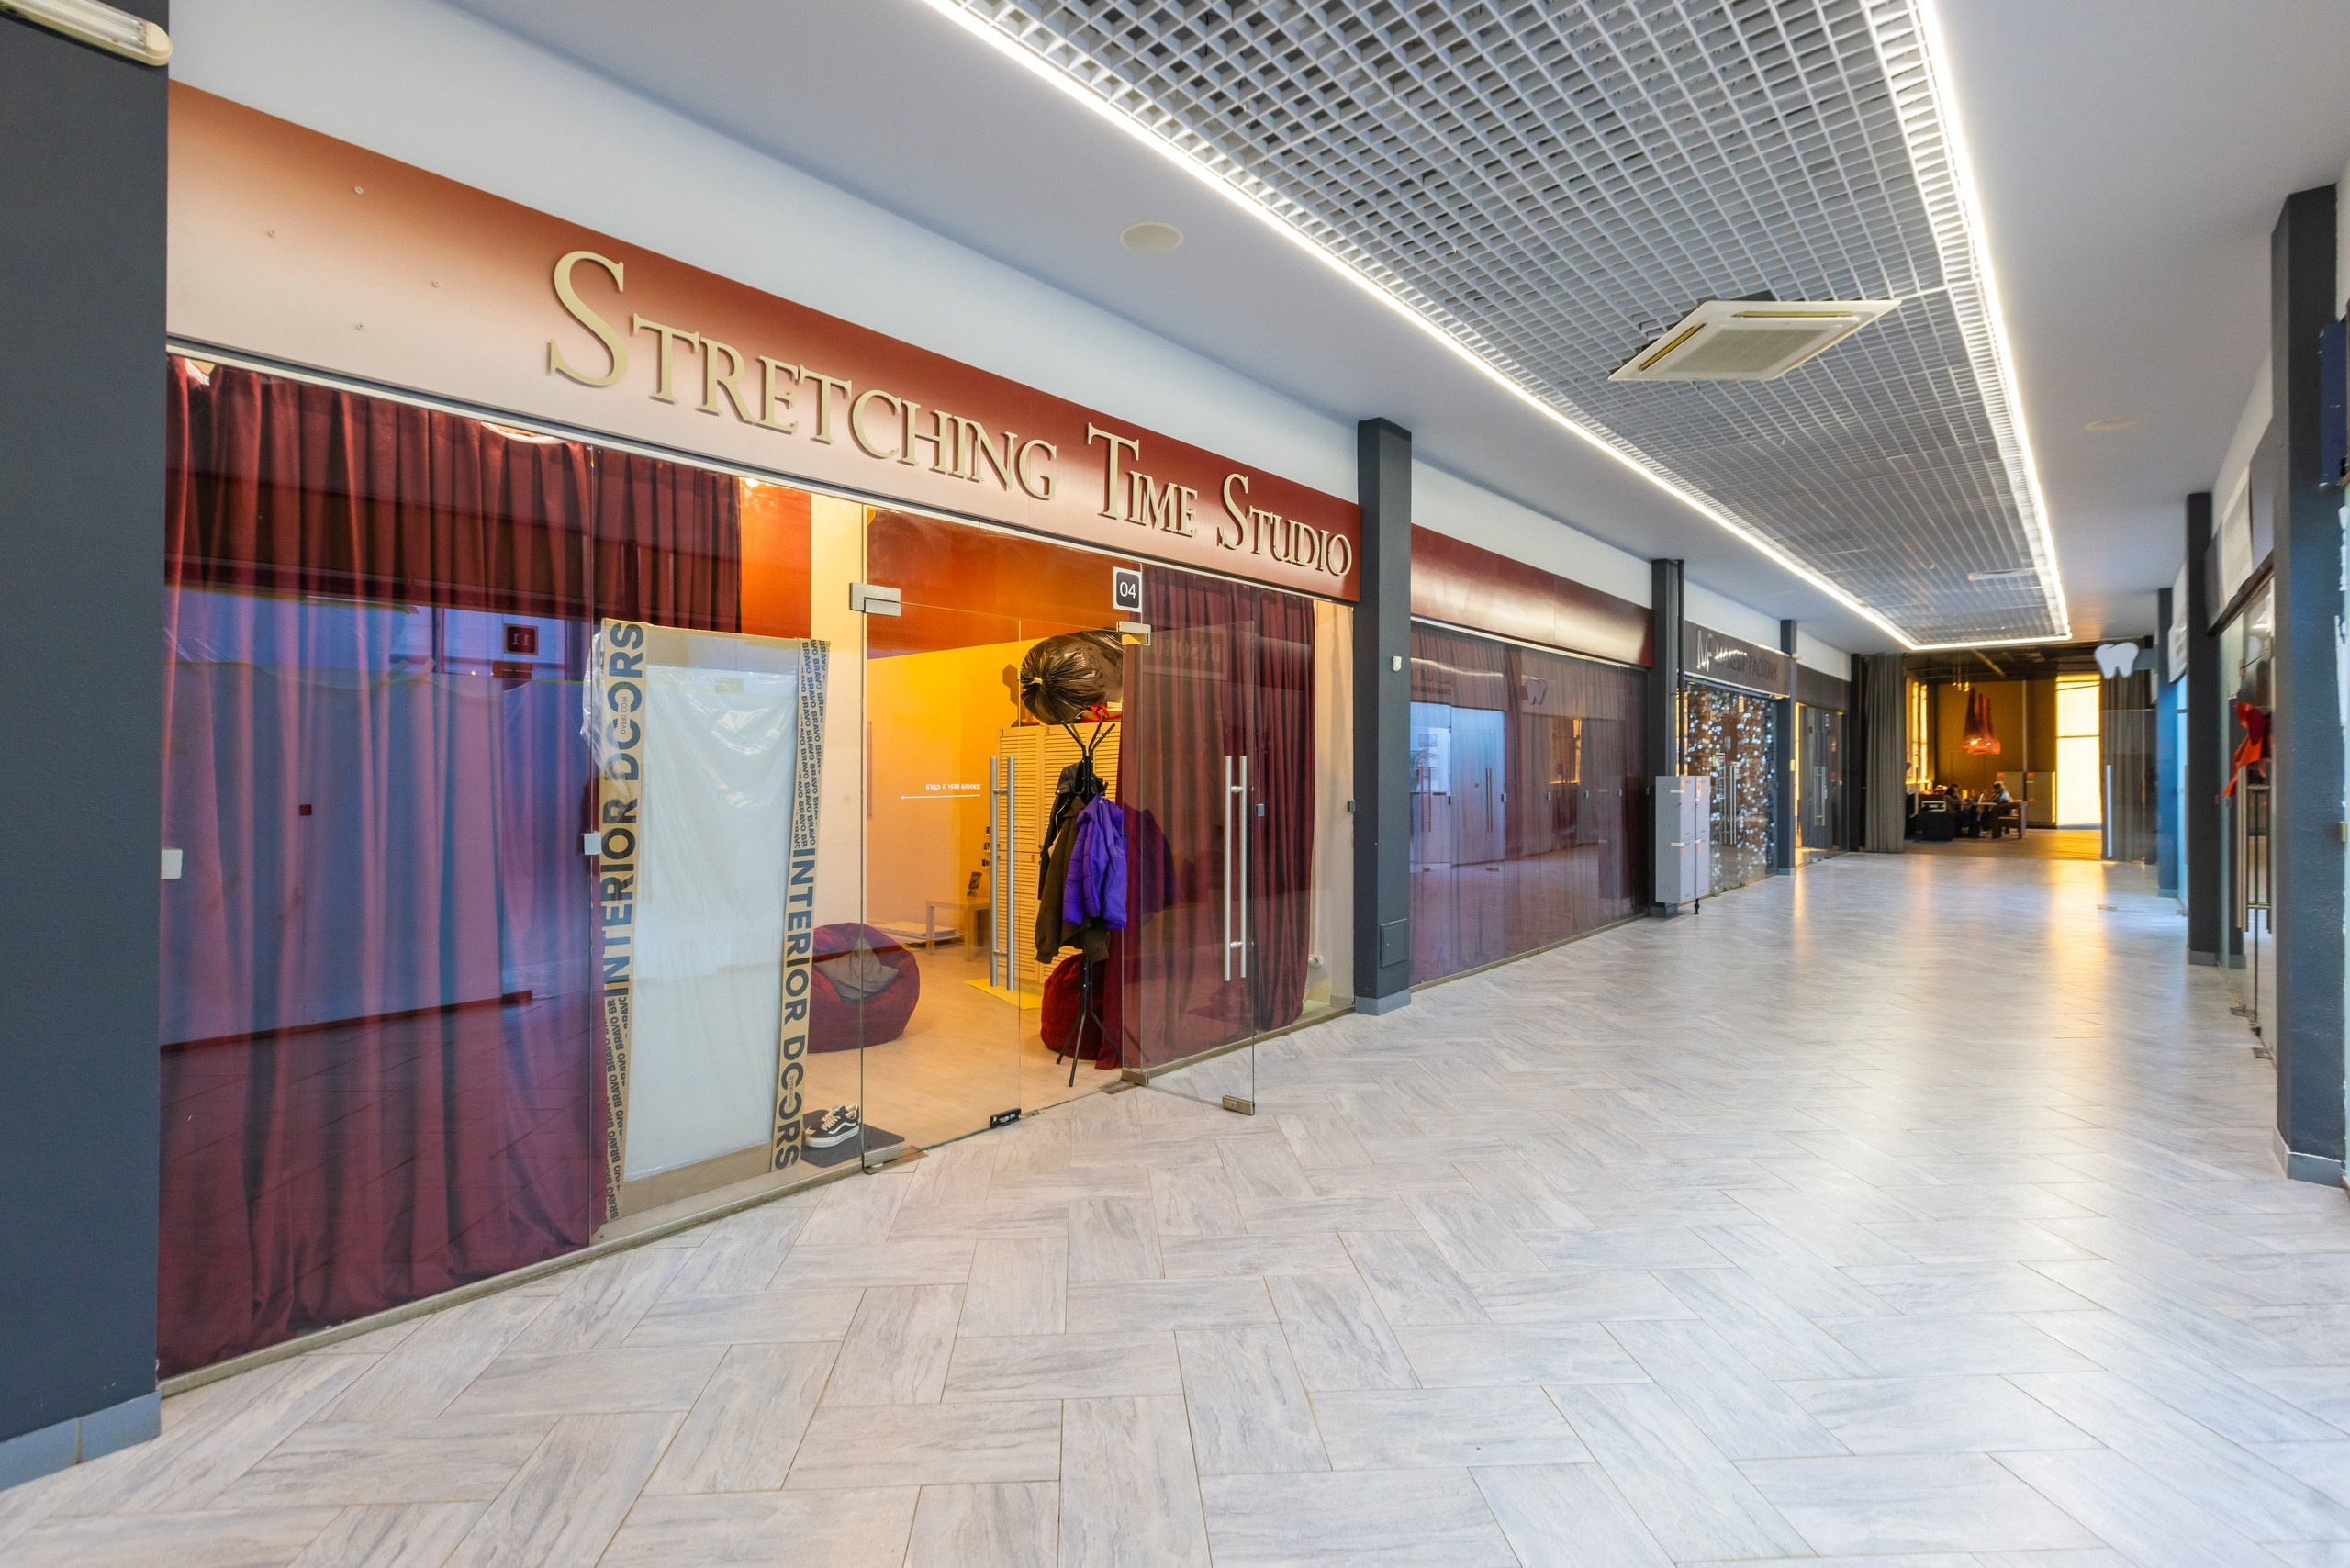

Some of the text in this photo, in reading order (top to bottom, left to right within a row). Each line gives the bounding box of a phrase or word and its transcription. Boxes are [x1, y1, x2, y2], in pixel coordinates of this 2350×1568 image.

[550, 250, 1353, 577] STRETCHING TIME STUDIO
[1120, 581, 1136, 599] 04
[802, 642, 811, 674] BRAVO
[813, 658, 822, 689] BRAVO
[807, 677, 816, 708] BRAVO
[801, 695, 811, 726] BRAVO
[811, 711, 820, 742] BRAVO
[1045, 726, 1051, 735] 2
[806, 730, 815, 760] BRAVO
[801, 748, 810, 779] BRAVO
[810, 764, 818, 793] BRAVO
[804, 782, 812, 812] BRAVO
[600, 798, 638, 998] INTERIOR
[784, 848, 815, 1025] INTERIOR
[610, 1016, 624, 1050] BRAVO
[606, 1038, 616, 1072] BRAVO
[609, 1074, 622, 1108] BRAVO
[608, 1131, 620, 1163] BRAVO
[606, 1187, 619, 1219] BRAVO
